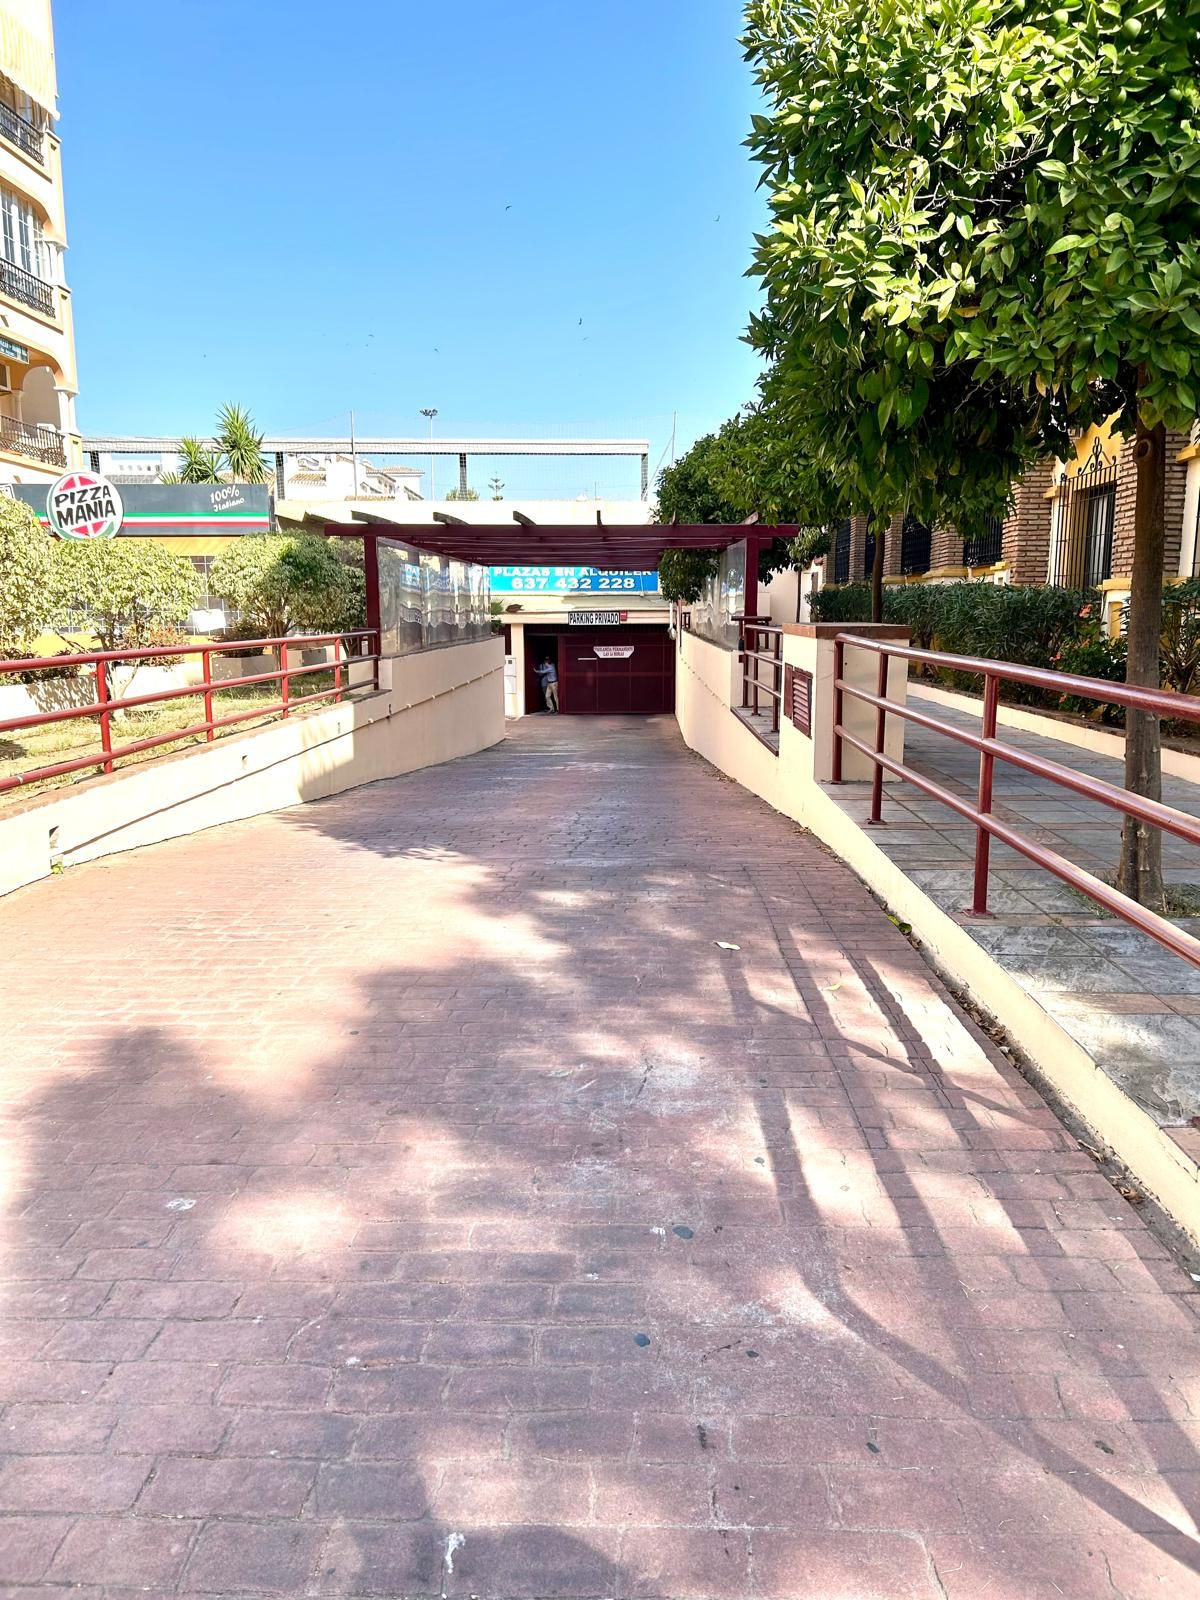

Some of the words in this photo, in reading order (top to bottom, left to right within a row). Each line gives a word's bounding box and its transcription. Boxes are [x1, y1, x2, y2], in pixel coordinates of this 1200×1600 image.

[54, 485, 111, 508] PIZZA
[210, 485, 240, 503] 100%
[56, 500, 116, 528] MANIA
[494, 567, 551, 577] PLAZAS
[555, 567, 575, 577] EN
[512, 578, 549, 589] 637
[555, 578, 592, 589] 432
[598, 578, 635, 589] 228
[570, 613, 594, 624] PARKING
[594, 613, 619, 624] PRIVADO
